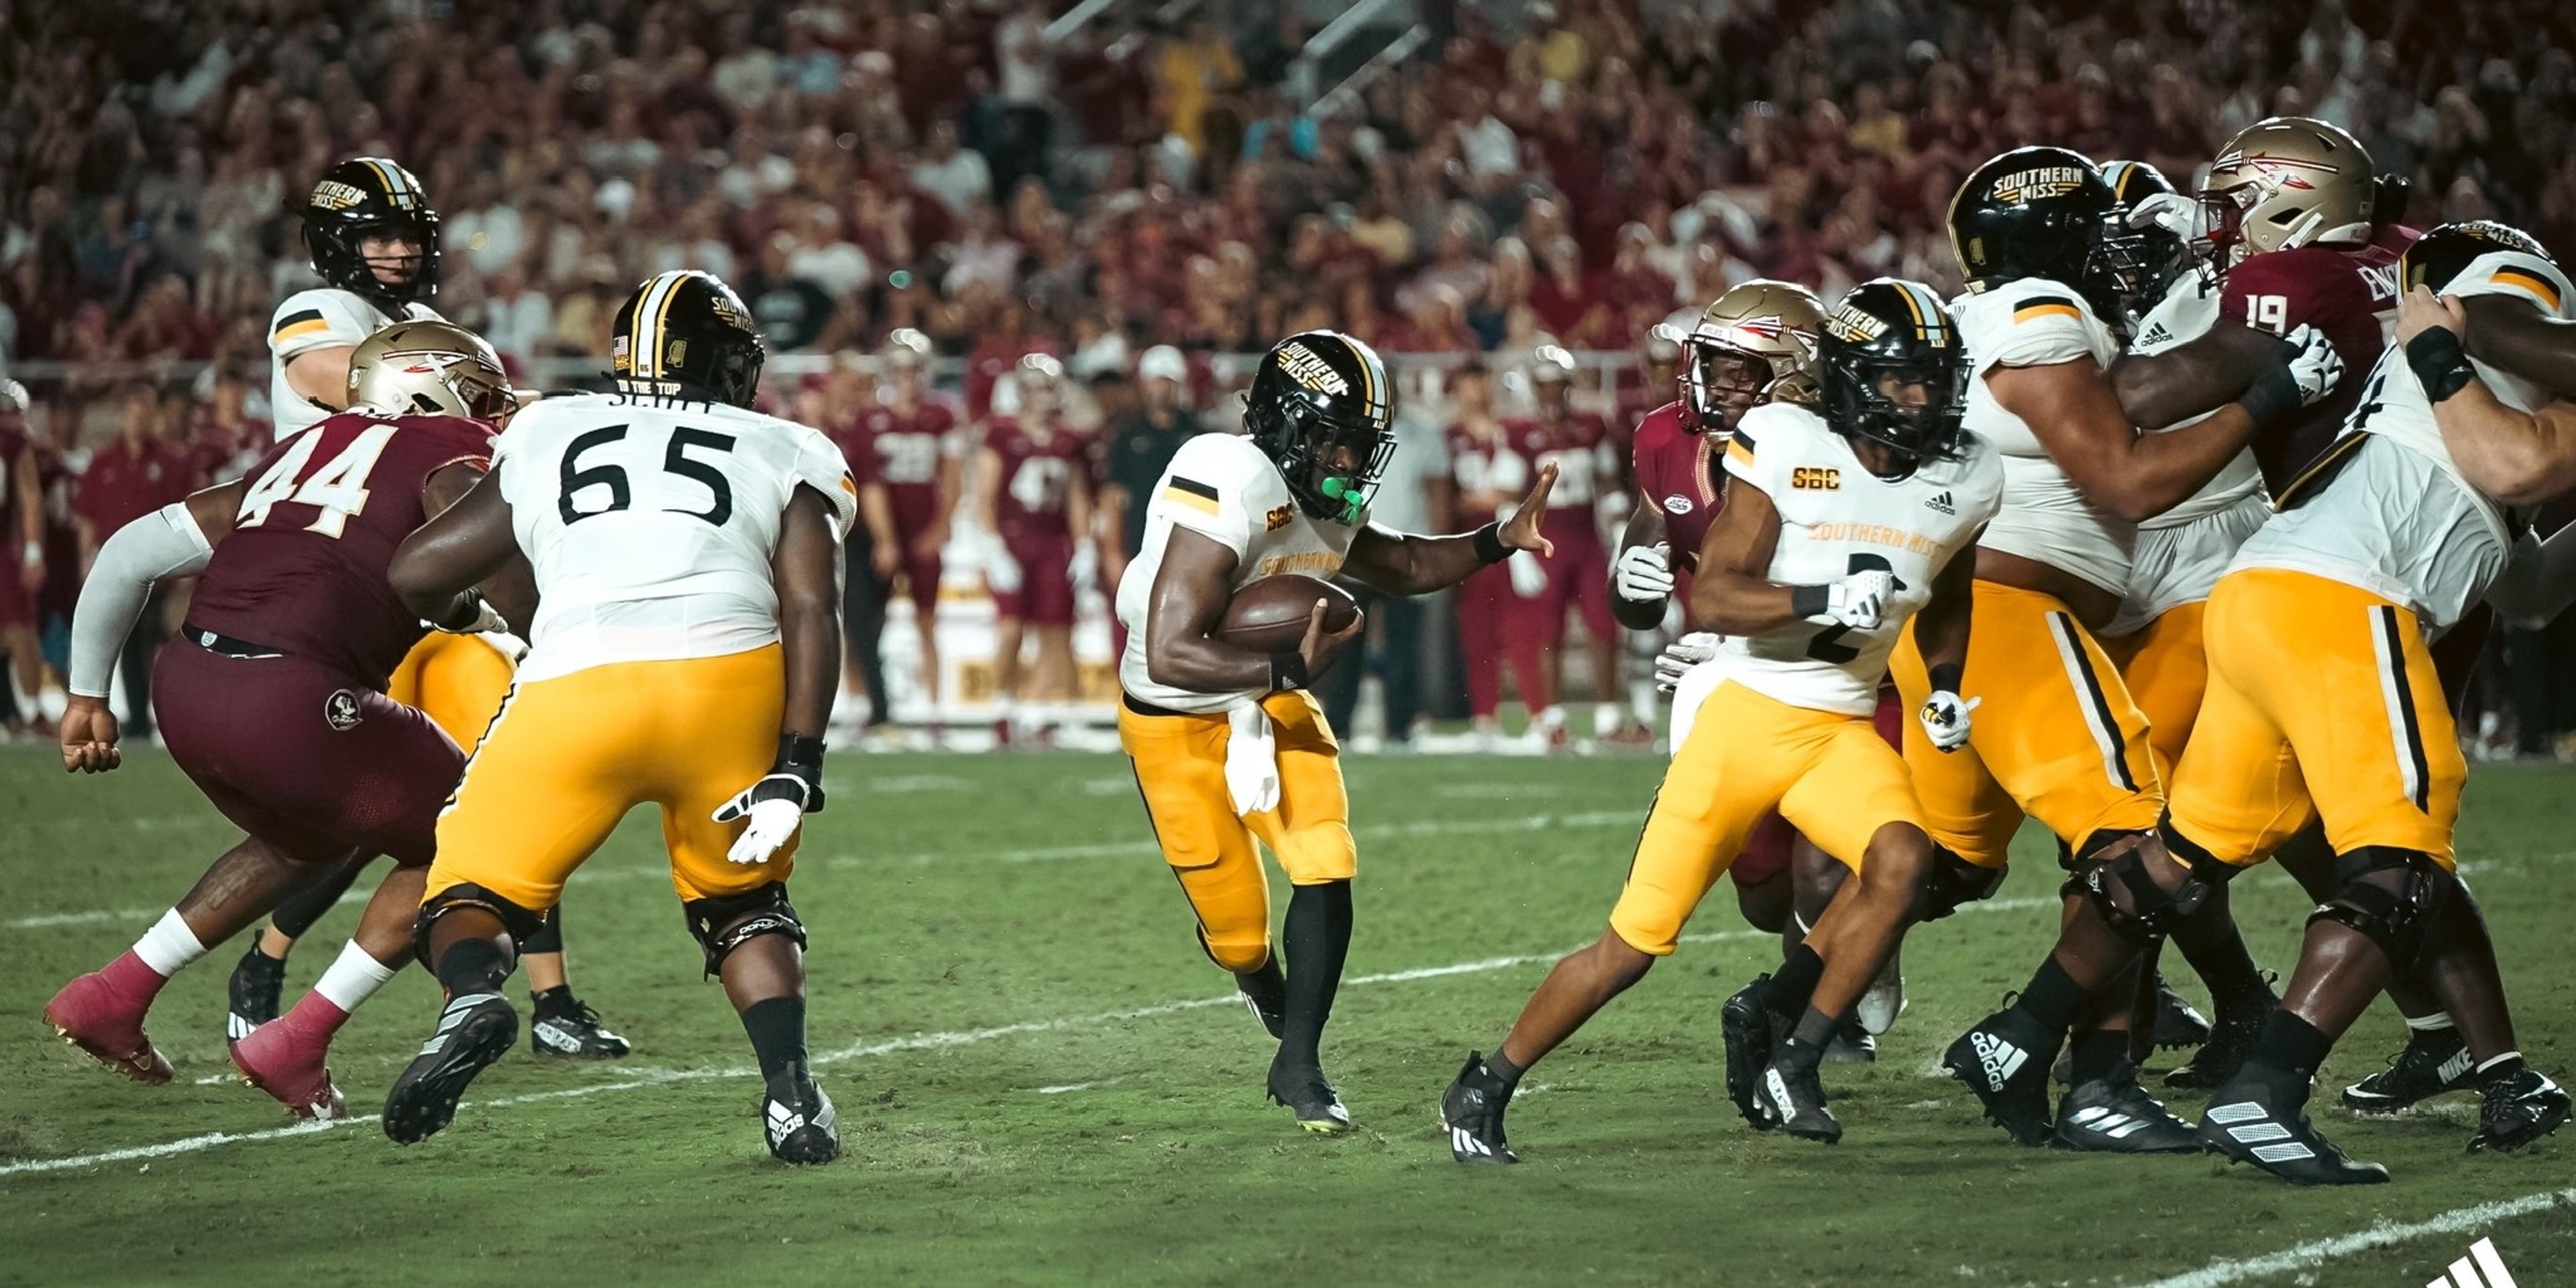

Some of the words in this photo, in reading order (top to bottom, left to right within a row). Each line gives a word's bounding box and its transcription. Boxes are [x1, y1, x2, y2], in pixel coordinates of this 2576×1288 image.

[1993, 167, 2084, 195] SOUTHERN
[2020, 182, 2058, 203] MISS
[2486, 231, 2524, 250] MISS
[2245, 294, 2288, 338] 19
[2141, 334, 2174, 346] adidas
[1282, 358, 1313, 384] MISS
[1285, 341, 1349, 396] SOUTHERN
[631, 380, 652, 394] THE
[656, 382, 682, 396] TOP
[235, 424, 400, 539] 44
[558, 424, 737, 527] 65
[1792, 467, 1840, 490] SBC
[1667, 498, 1689, 511] ACC
[1925, 500, 1955, 516] adidas
[1808, 523, 1905, 548] SOUTHERN
[1970, 1031, 2004, 1093] adidas
[2436, 1045, 2475, 1085] NIKE
